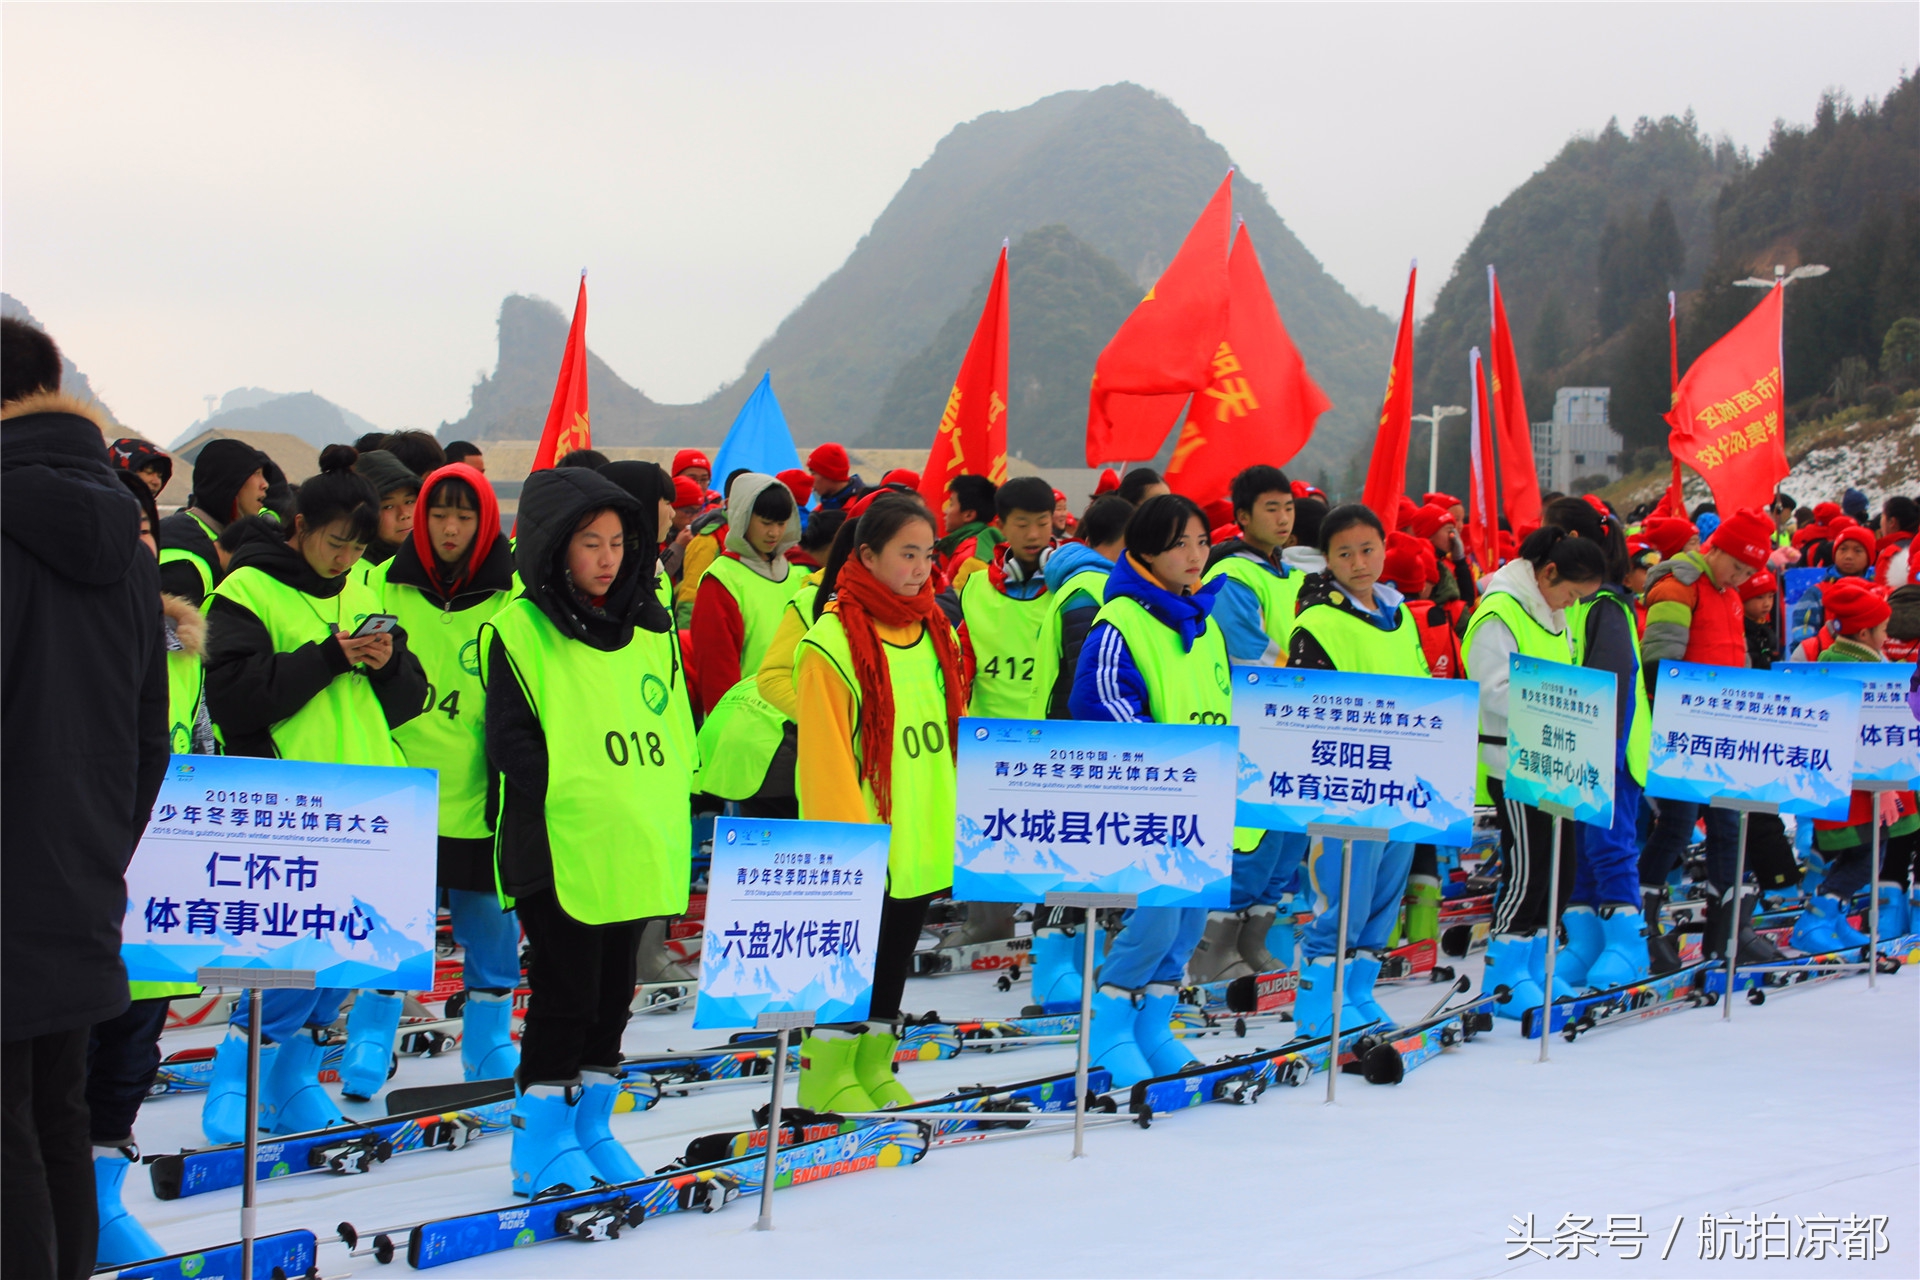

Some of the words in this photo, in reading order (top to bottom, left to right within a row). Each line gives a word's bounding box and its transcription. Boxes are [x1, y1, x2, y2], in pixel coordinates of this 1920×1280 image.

[984, 655, 1035, 681] 412
[1264, 703, 1444, 730] 青少年冬季阳光体育大会
[1681, 693, 1831, 722] 青少年冬季阳光体育大会
[605, 731, 665, 766] 018
[903, 721, 948, 758] 00
[1541, 724, 1576, 753] 盘州市
[1665, 731, 1833, 772] 黔西南州代表队
[1311, 740, 1392, 771] 绥阳县
[1519, 748, 1600, 790] 乌蒙镇中心小学
[994, 761, 1198, 783] 青少年冬季阳光体育大会
[1269, 772, 1432, 809] 体育运动中心
[151, 804, 390, 834] 少年冬季阳光体育大会
[983, 808, 1205, 848] 水城县代表队
[152, 826, 171, 836] 2018
[172, 827, 194, 836] China
[196, 829, 225, 838] guizhou
[225, 830, 247, 839] youth
[248, 832, 270, 840] winter
[272, 832, 304, 842] sunshine
[306, 834, 329, 844] sports
[331, 836, 371, 845] conference
[206, 851, 319, 891] 仁怀市
[737, 867, 864, 885] 青少年冬季阳光体育大会
[145, 897, 374, 940] 体育事业中心
[722, 919, 862, 959] 六盘水代表队
[792, 1162, 832, 1186] SNOW
[832, 1154, 878, 1176] PANDA
